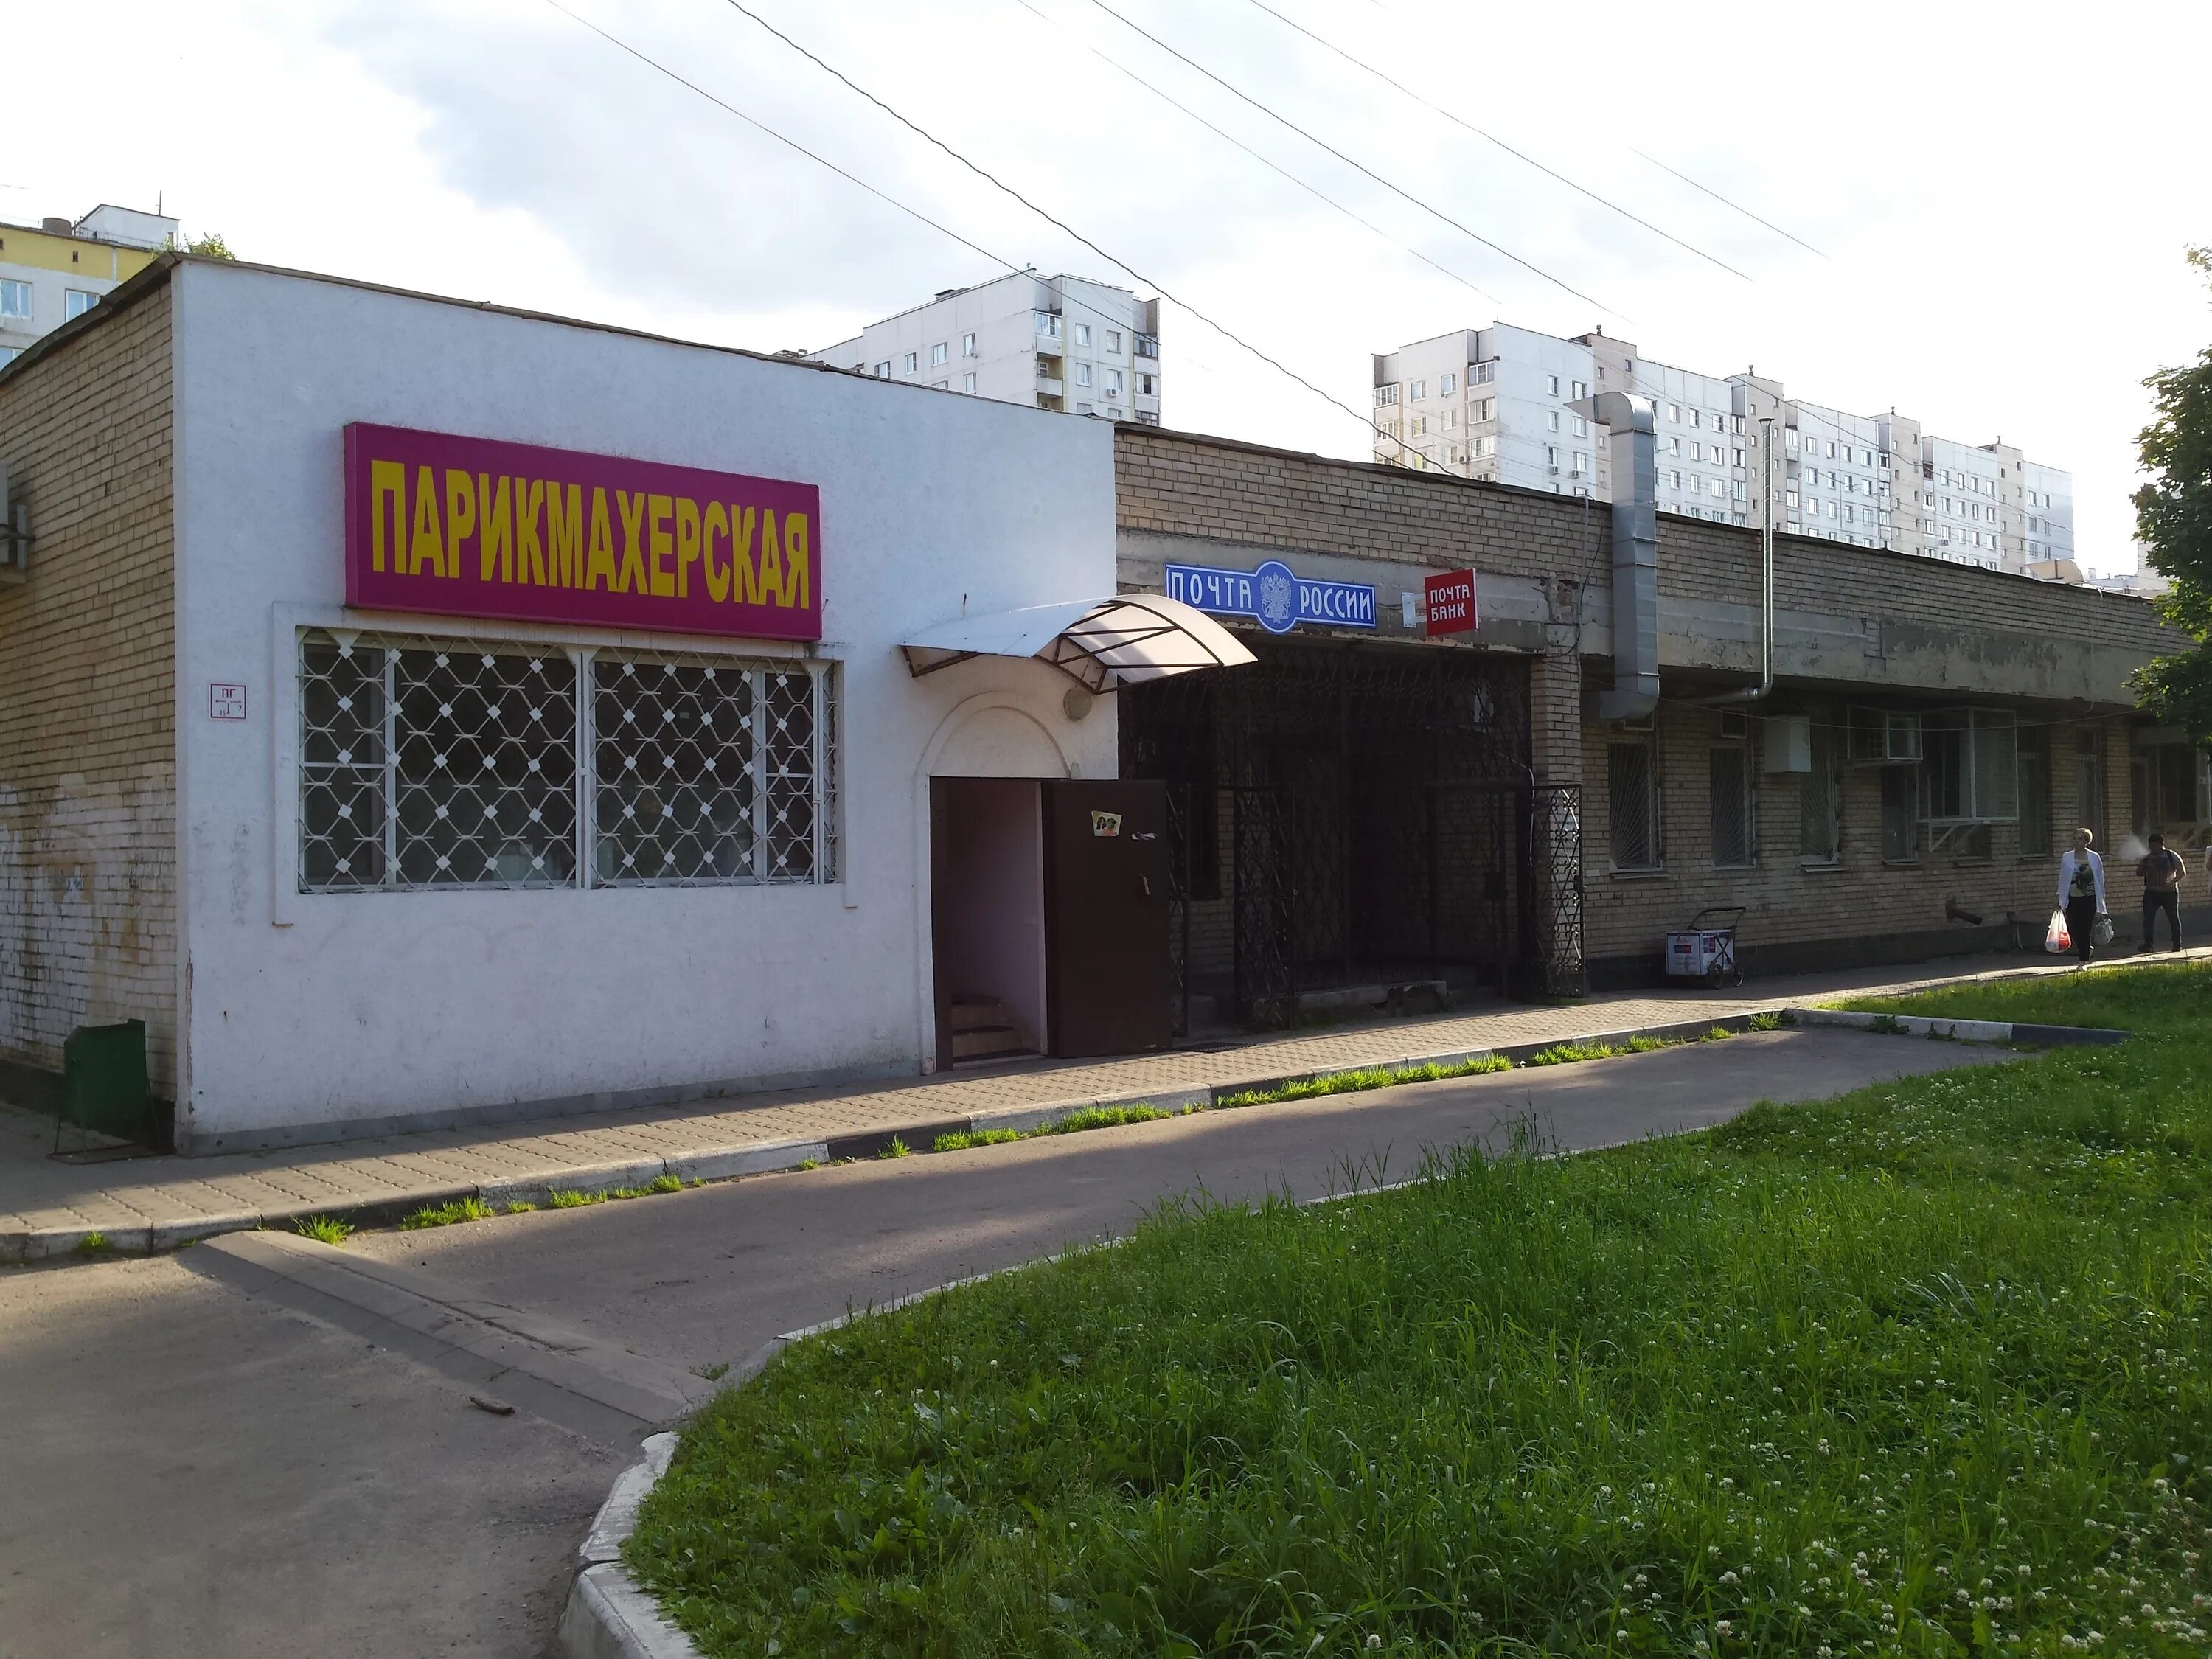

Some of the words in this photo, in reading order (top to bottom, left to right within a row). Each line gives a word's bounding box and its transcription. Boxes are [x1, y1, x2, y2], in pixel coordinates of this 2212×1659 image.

[371, 459, 810, 610] ПАРИКМАХЕРСКАЯ
[1171, 571, 1253, 609] ПОЧТА
[1300, 585, 1371, 620] РОССИИ
[1430, 584, 1470, 604] ПОЧТА
[1430, 602, 1466, 622] БАНК
[222, 688, 236, 698] ПГ
